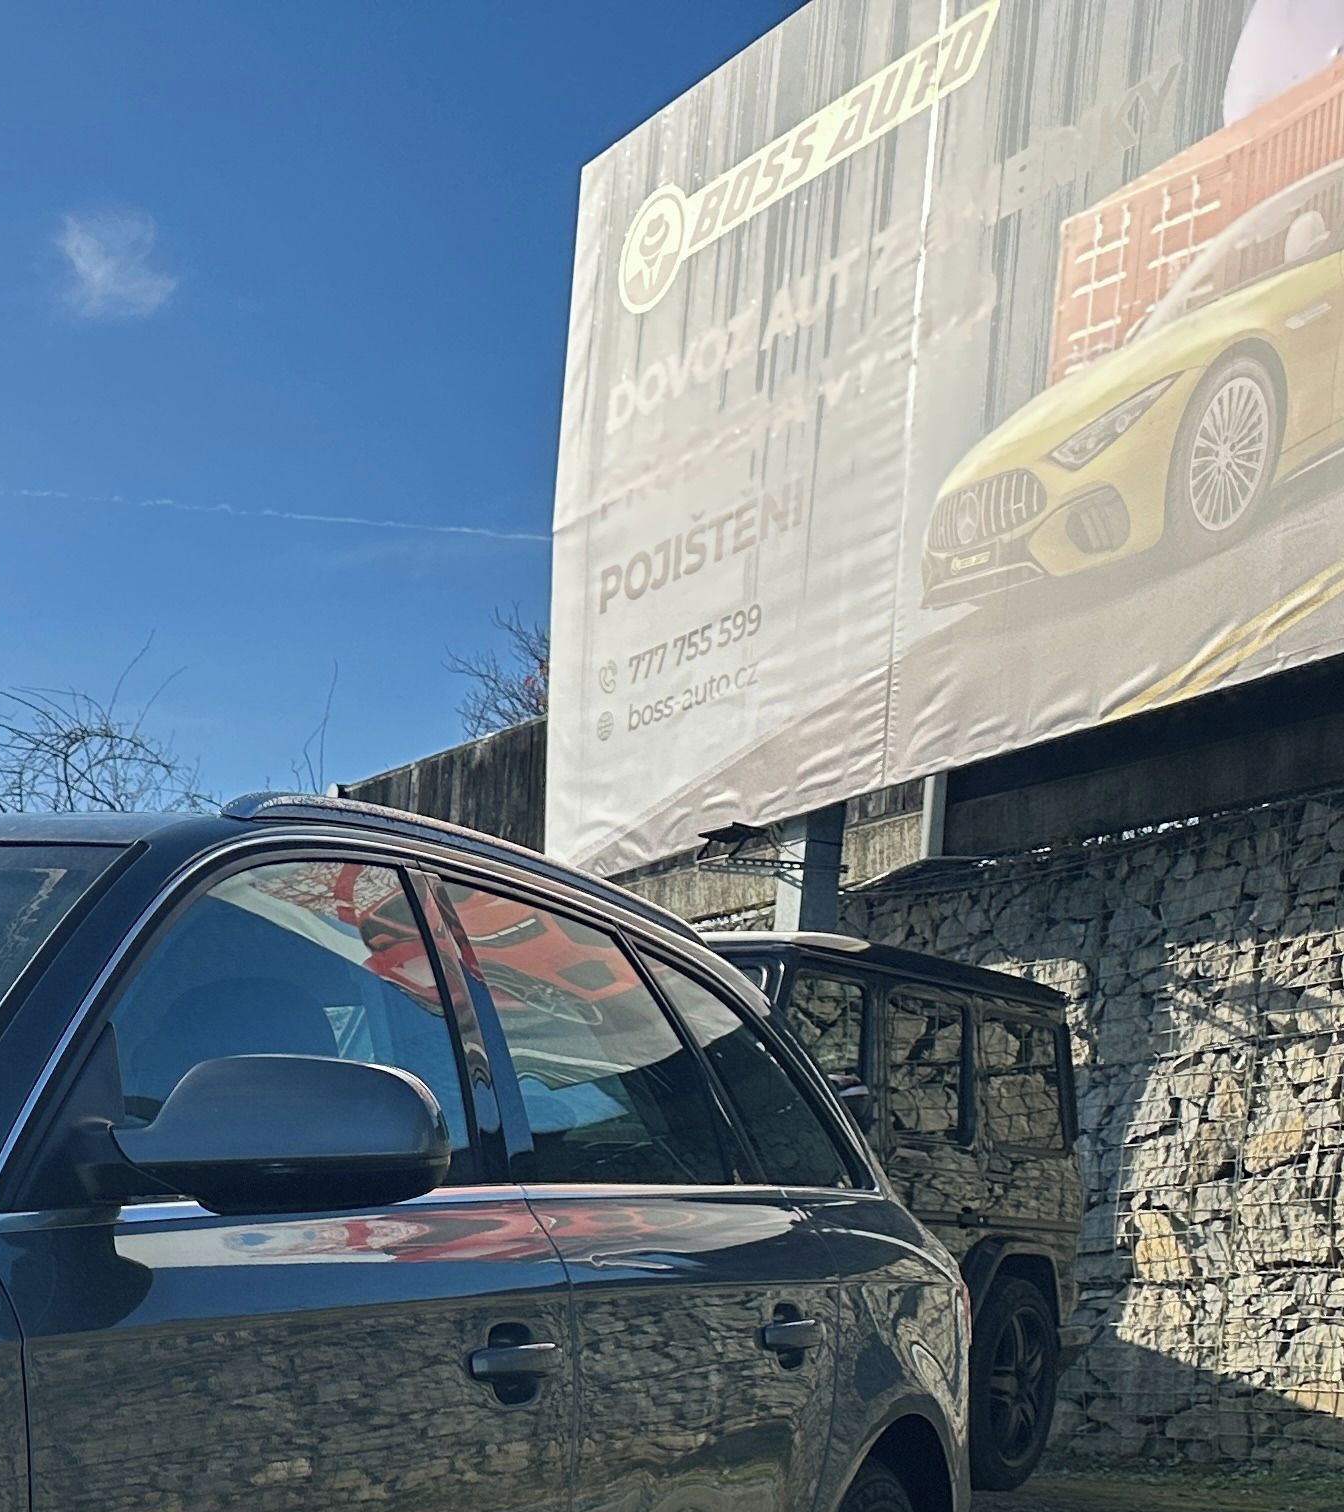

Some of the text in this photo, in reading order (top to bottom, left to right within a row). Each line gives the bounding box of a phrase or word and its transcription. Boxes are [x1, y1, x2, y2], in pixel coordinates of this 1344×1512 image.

[689, 120, 819, 249] BOSS
[606, 307, 757, 435] DOVOZ
[761, 247, 862, 352] AUT
[628, 602, 763, 685] 777 755 599
